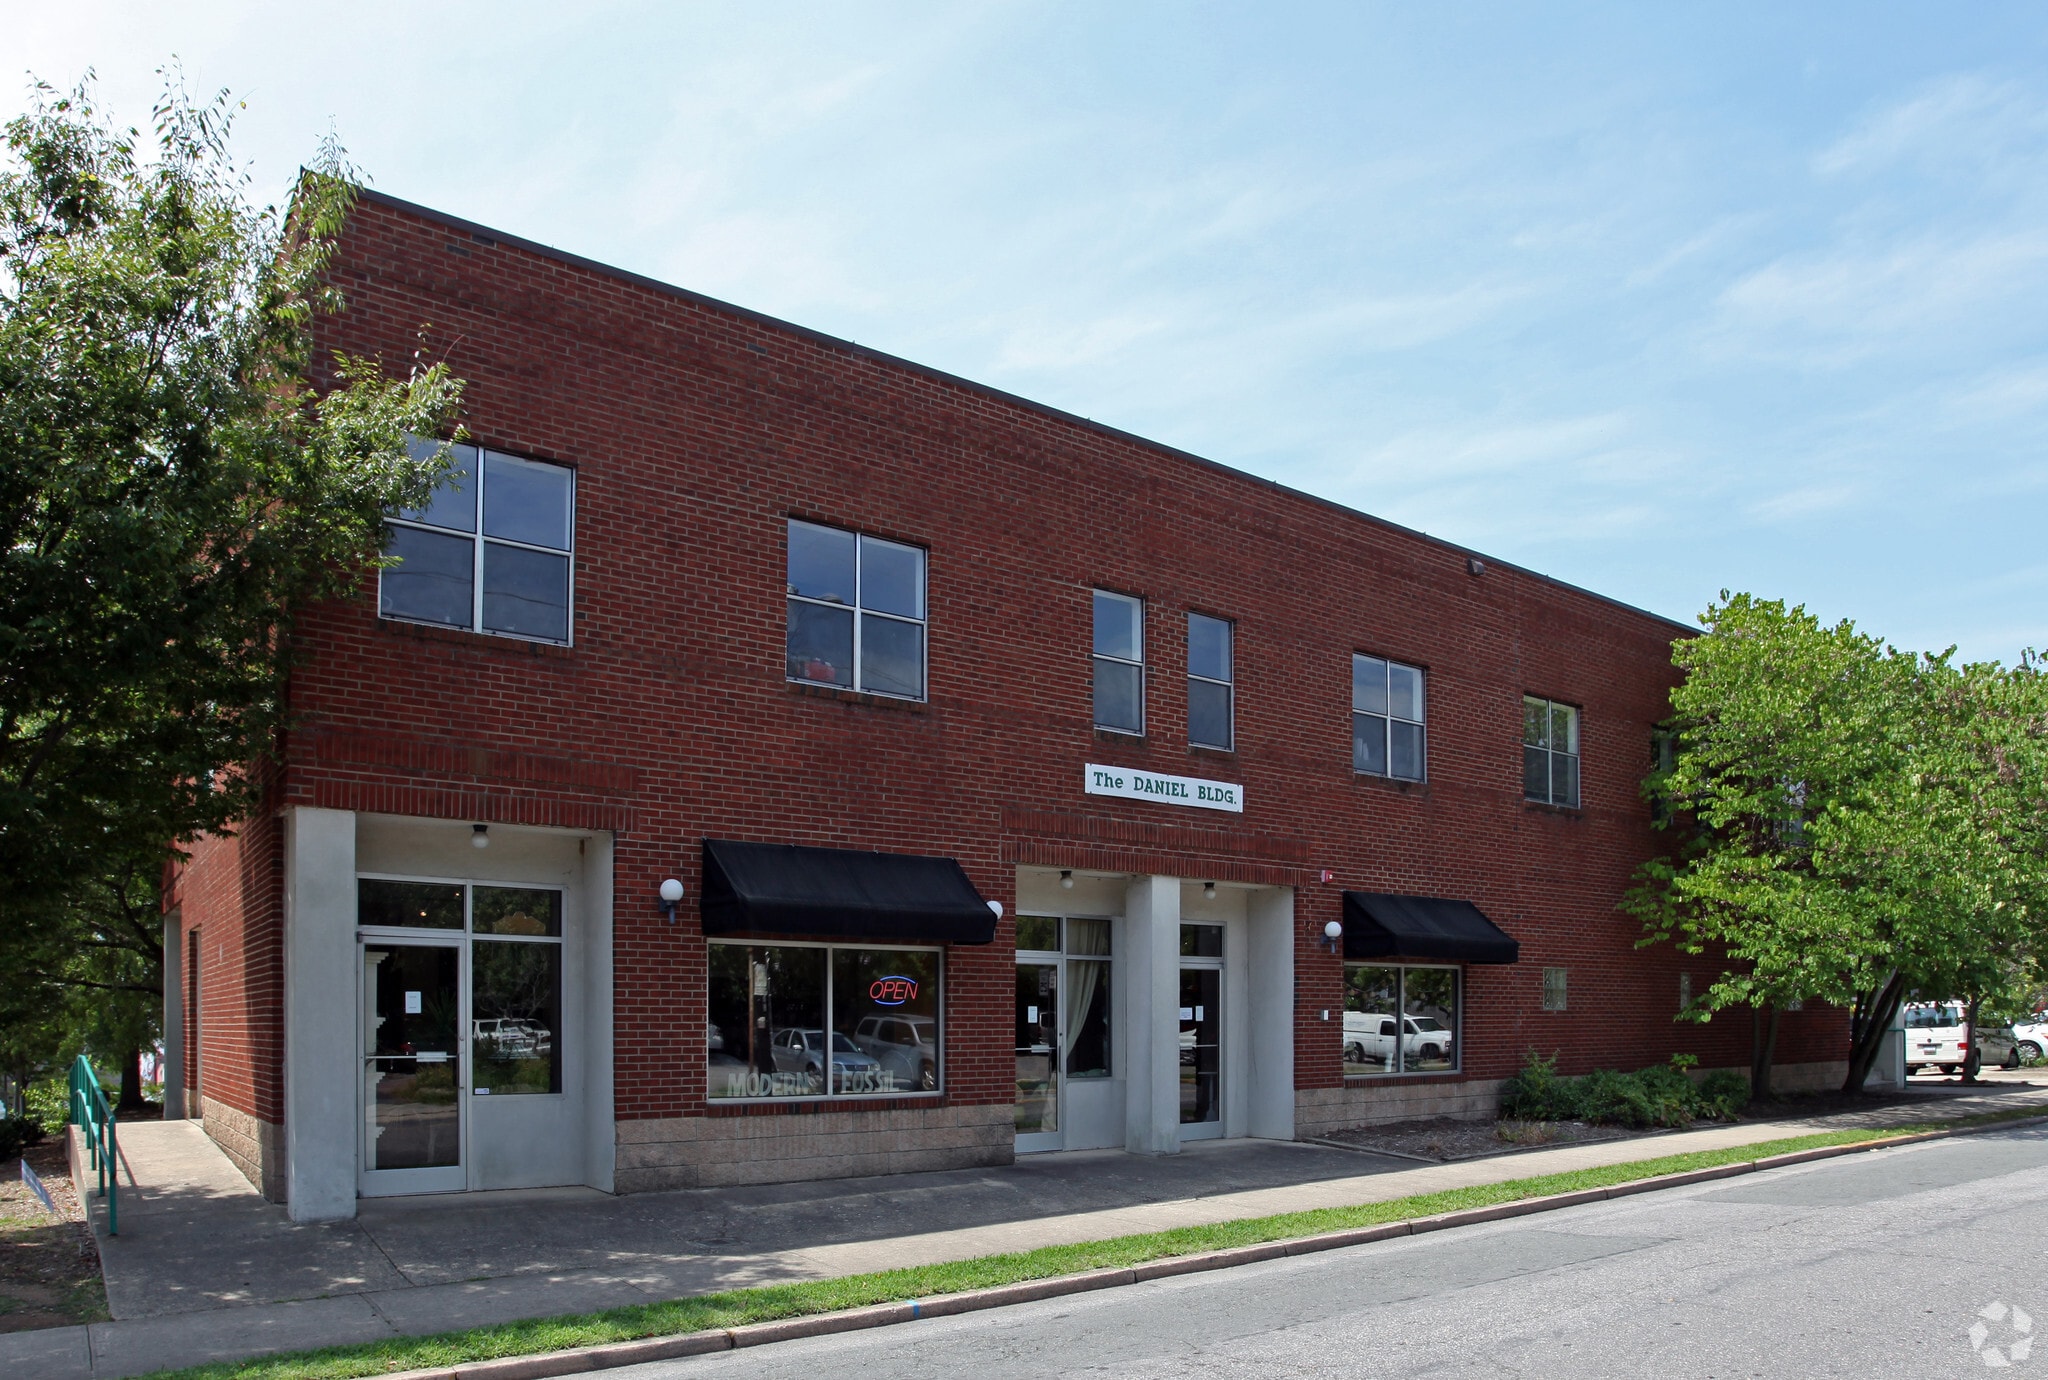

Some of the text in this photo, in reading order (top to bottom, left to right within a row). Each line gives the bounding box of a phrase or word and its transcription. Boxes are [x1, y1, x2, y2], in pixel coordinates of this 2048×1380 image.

[1093, 771, 1237, 805] The DANIEL BLDG.
[869, 981, 919, 1000] OPEN
[727, 1070, 900, 1097] MODERN FOSSIL
